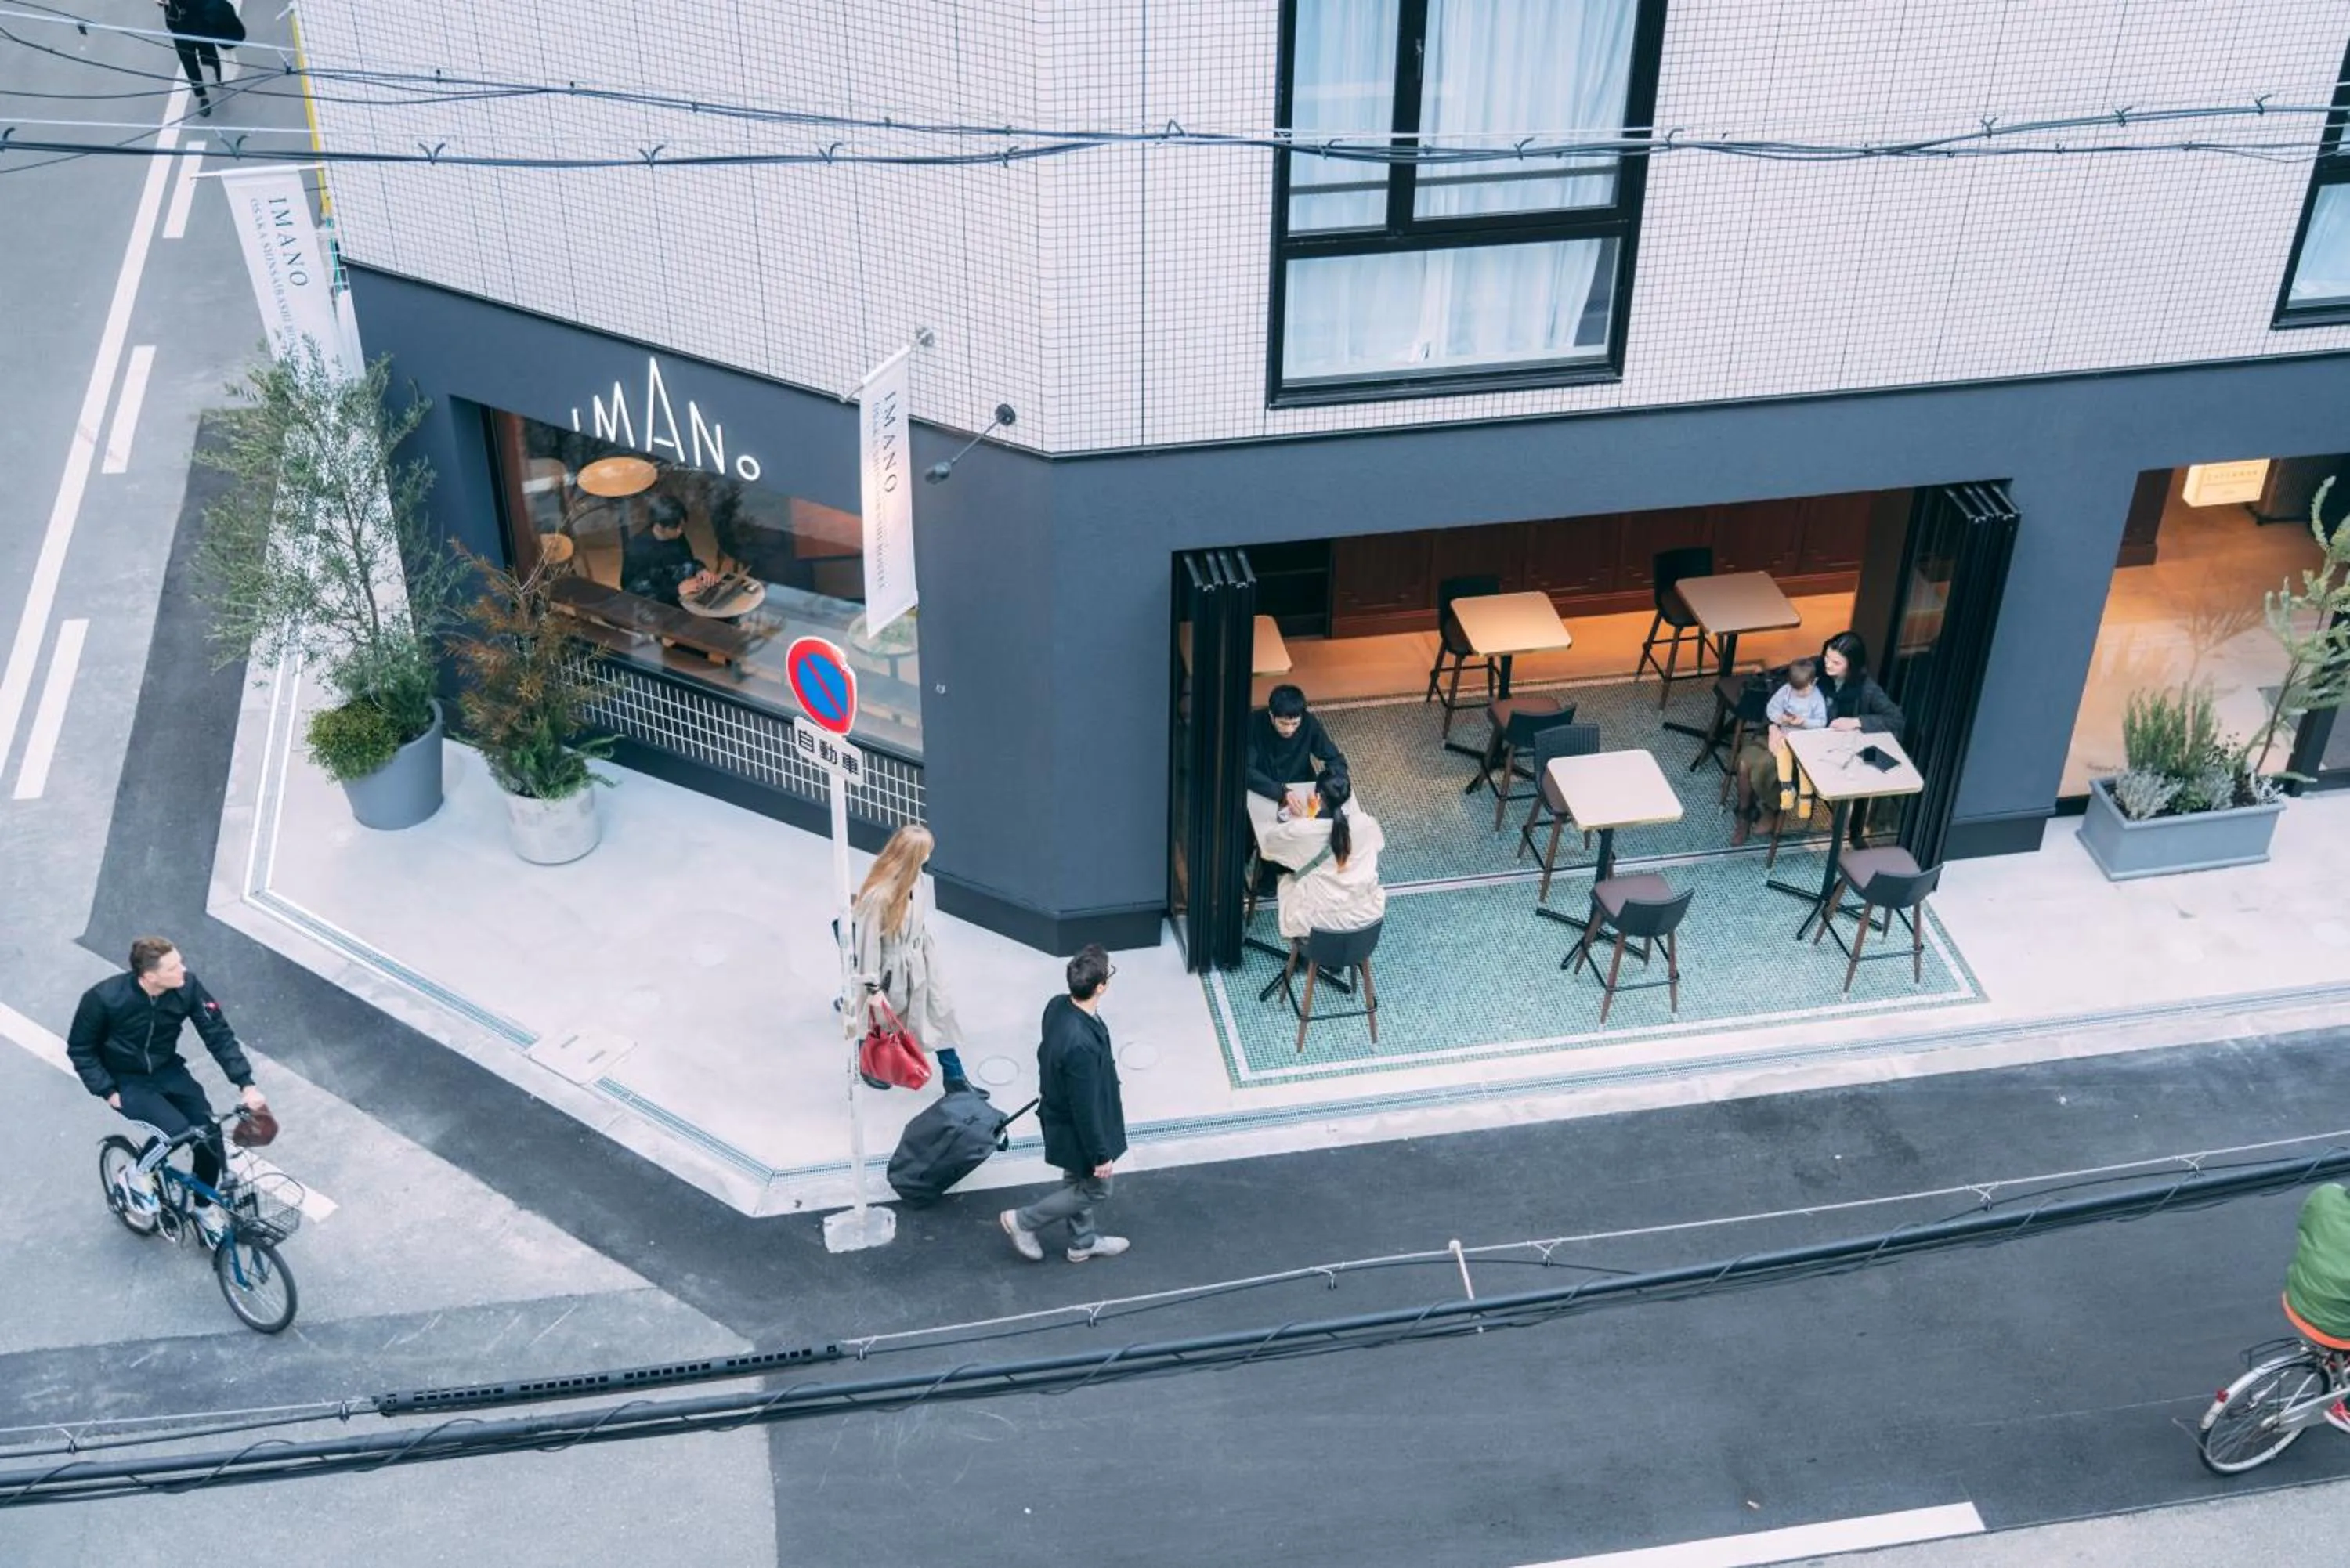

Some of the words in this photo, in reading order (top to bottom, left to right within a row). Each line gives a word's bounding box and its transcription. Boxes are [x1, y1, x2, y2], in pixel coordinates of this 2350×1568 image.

[269, 197, 308, 286] IMANO
[884, 391, 898, 492] IMANO
[797, 728, 859, 776] 自動車
